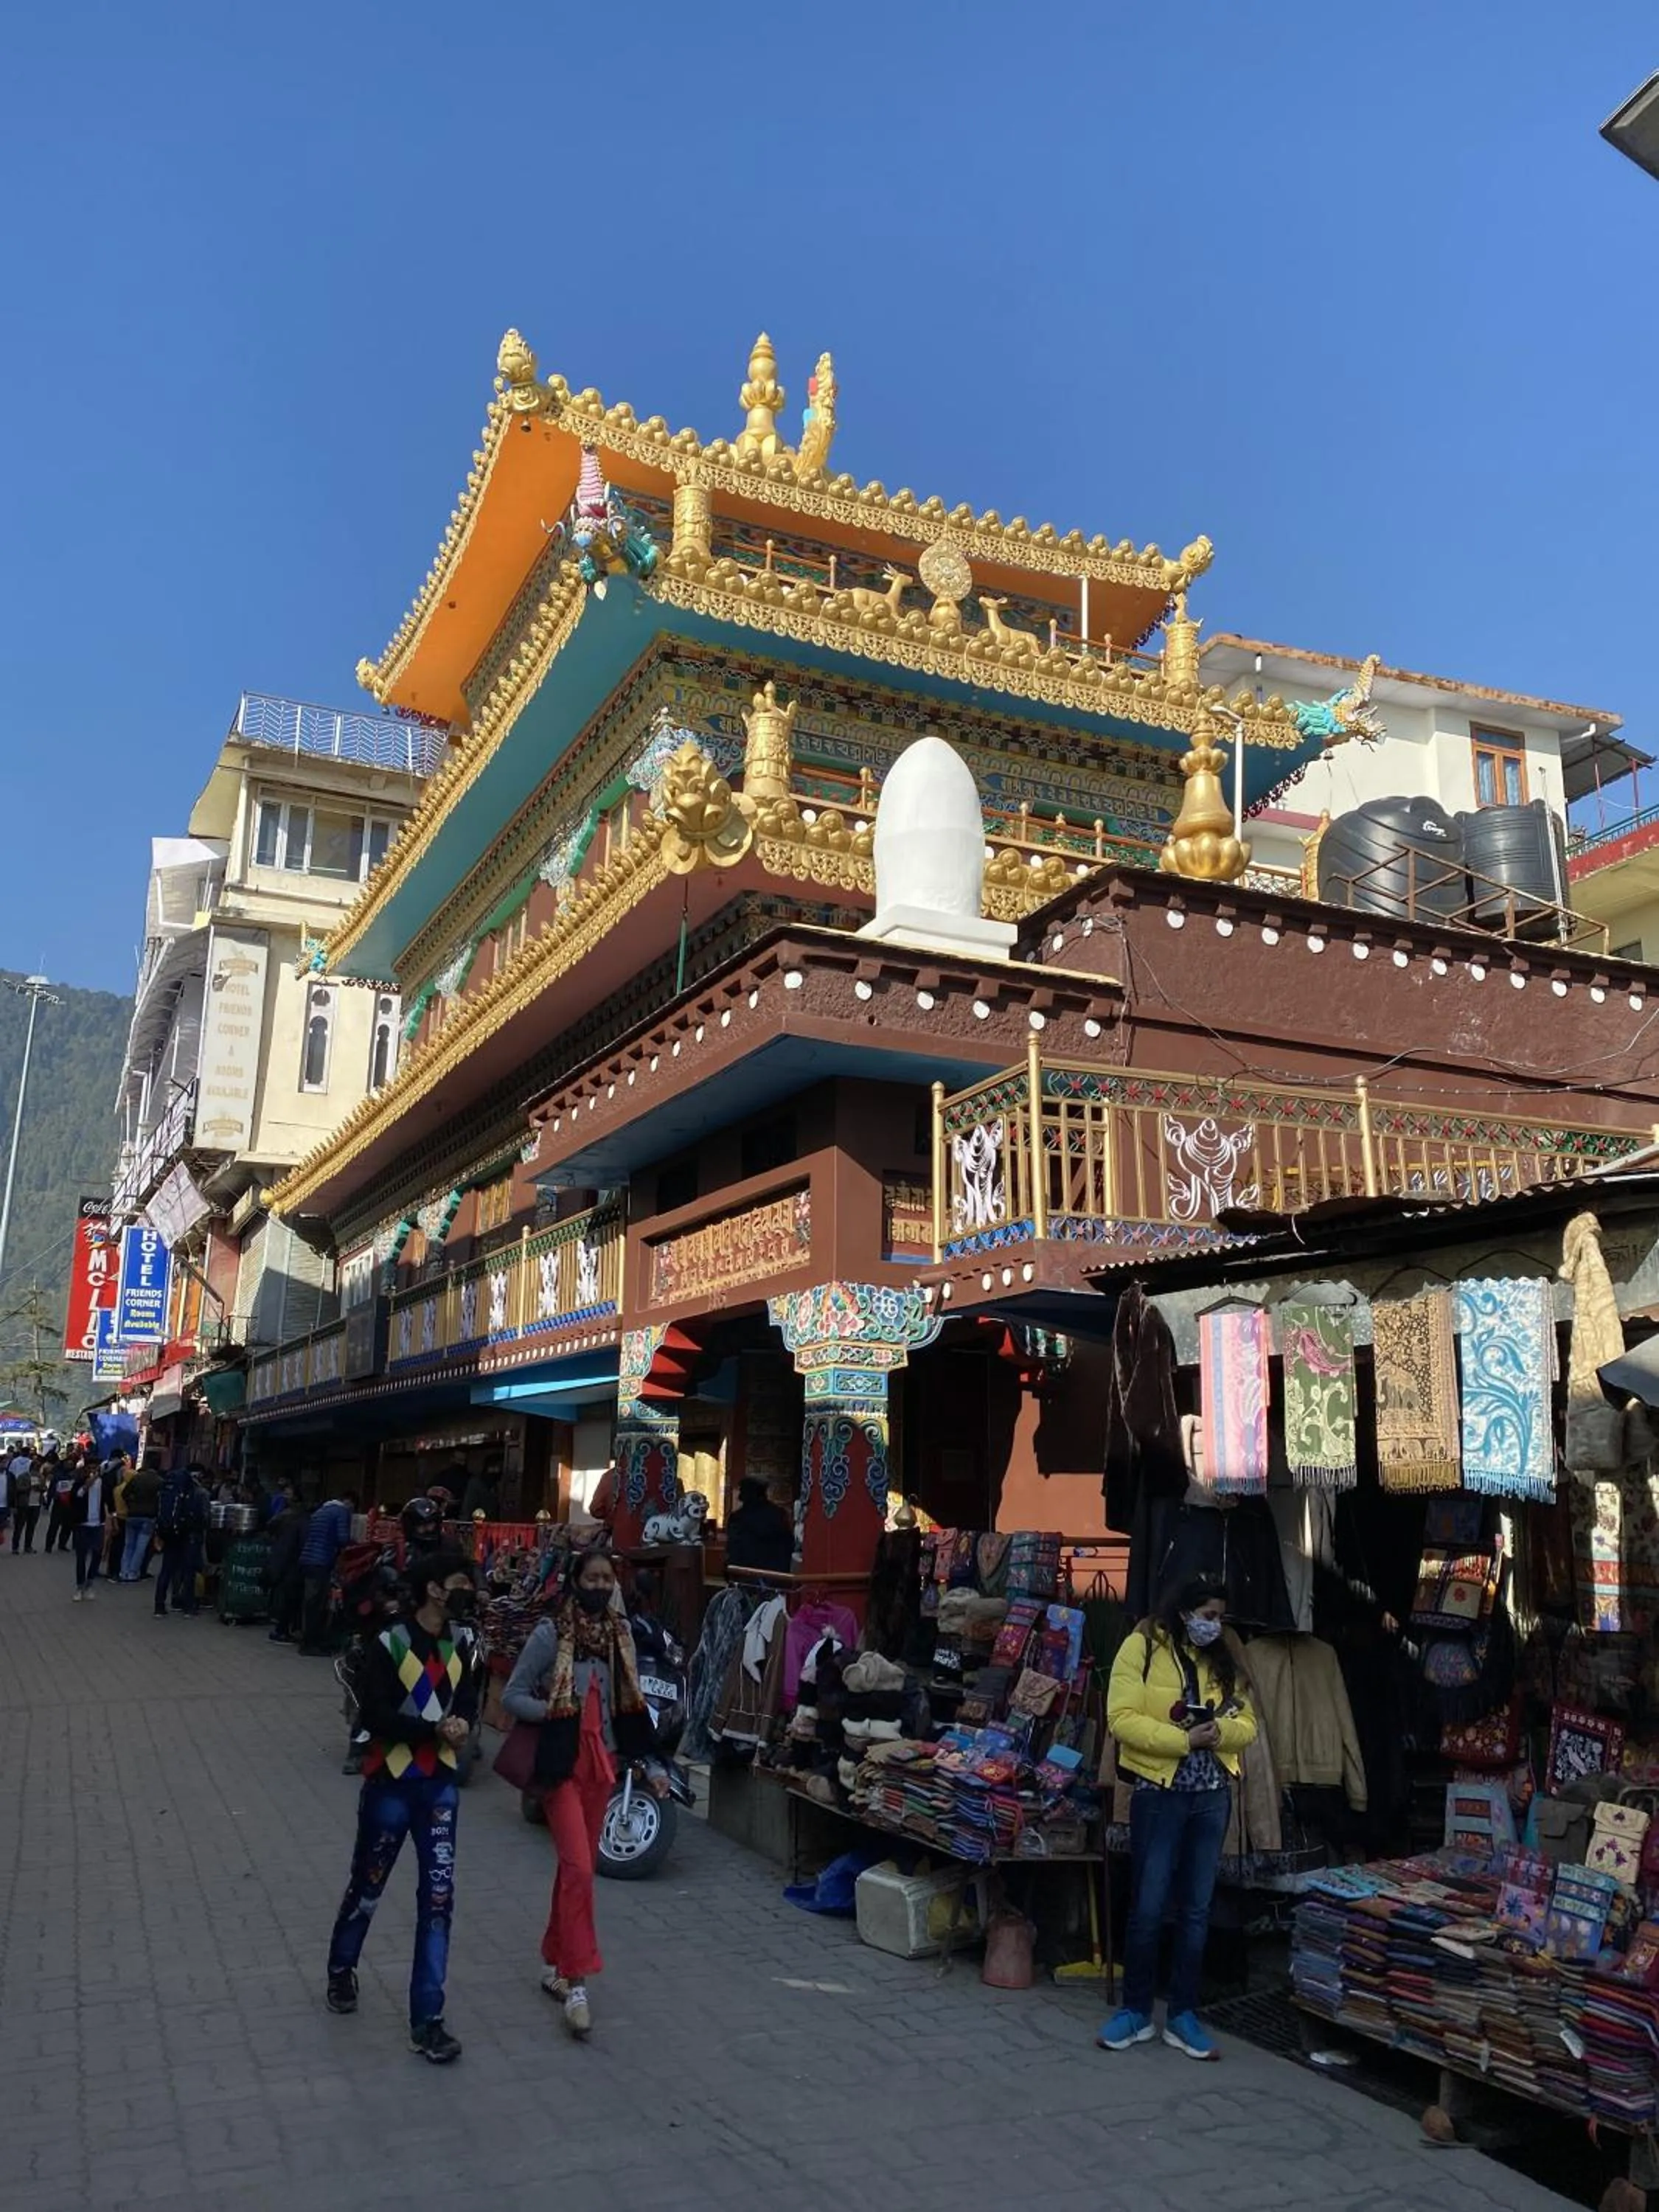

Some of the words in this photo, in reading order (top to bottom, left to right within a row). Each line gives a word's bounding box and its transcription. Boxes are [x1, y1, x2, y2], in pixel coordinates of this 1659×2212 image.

[140, 1230, 158, 1287] HOTEL
[125, 1288, 162, 1298] FRIENDS
[125, 1298, 161, 1309] CORNER
[130, 1309, 156, 1318] Rooms
[124, 1320, 160, 1329] Available
